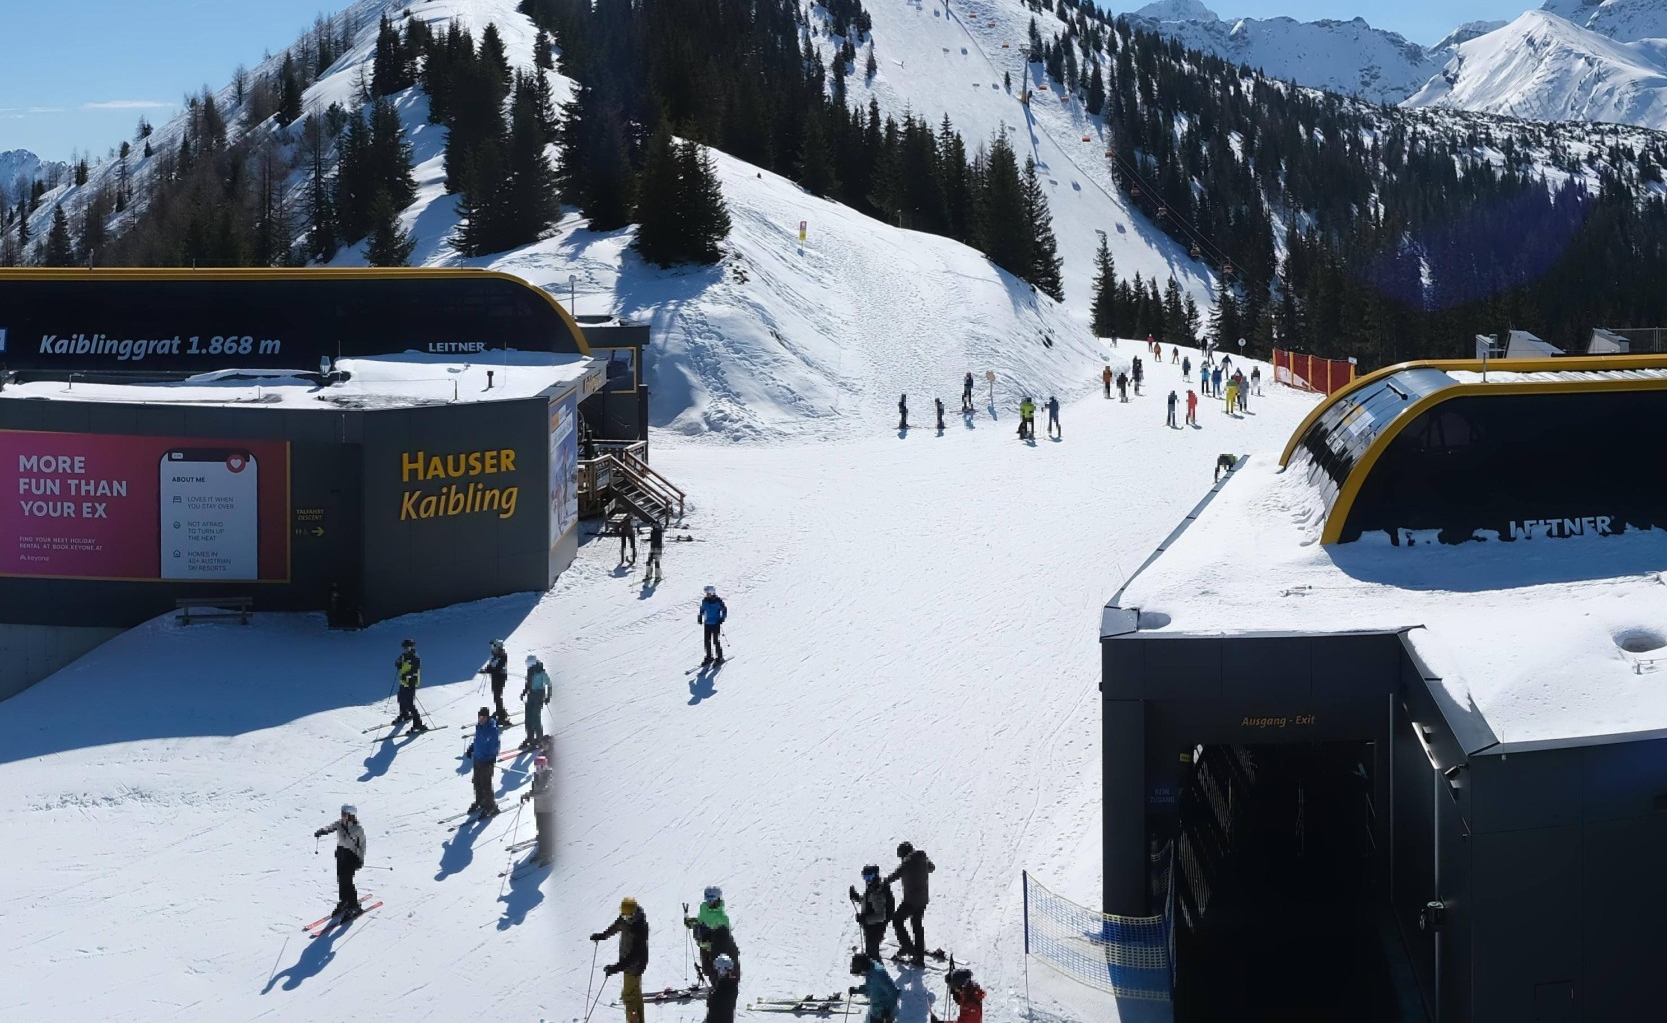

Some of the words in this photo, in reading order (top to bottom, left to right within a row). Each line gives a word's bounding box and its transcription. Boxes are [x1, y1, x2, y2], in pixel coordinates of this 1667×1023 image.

[39, 333, 181, 361] Kaiblinggrat
[186, 335, 253, 355] 1.868
[258, 338, 282, 355] m
[428, 342, 486, 353] LEITNER
[19, 455, 86, 474] MORE
[19, 478, 60, 496] FUN
[67, 479, 127, 497] THAN
[20, 500, 76, 518] YOUR
[82, 502, 108, 518] EX
[400, 482, 518, 521] Kaibling
[1241, 716, 1287, 728] Ausgang
[1295, 714, 1316, 725] Exit
